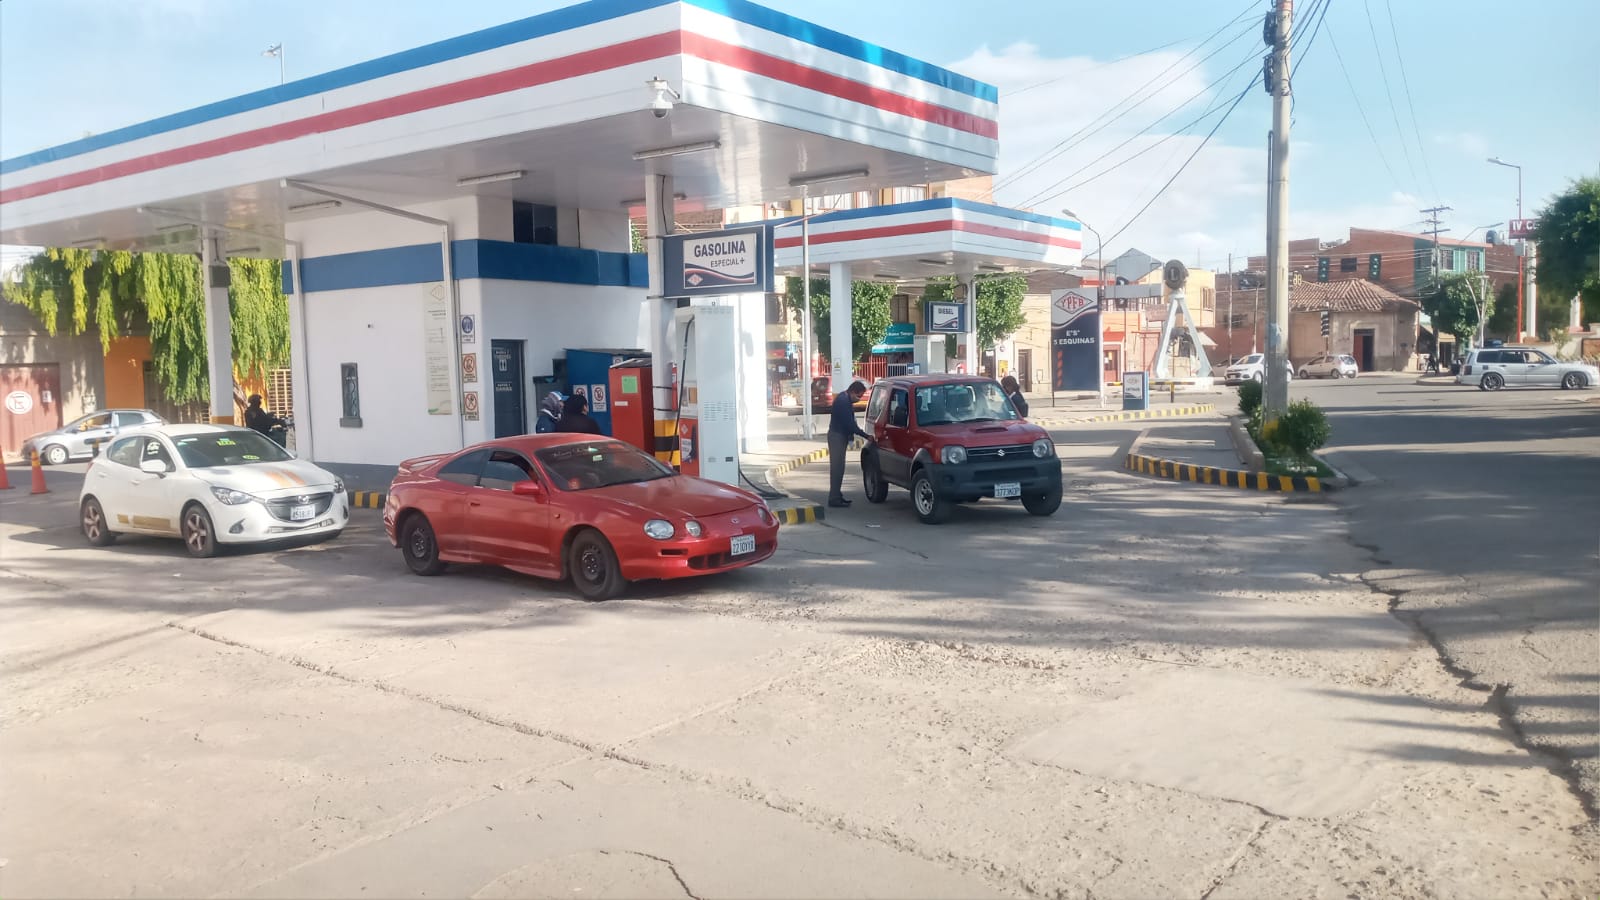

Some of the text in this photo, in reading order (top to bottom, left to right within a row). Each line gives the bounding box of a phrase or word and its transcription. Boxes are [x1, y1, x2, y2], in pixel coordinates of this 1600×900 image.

[694, 240, 746, 258] GASOLINA
[1061, 296, 1084, 310] YPFB
[938, 307, 954, 315] DIESEL
[1059, 337, 1095, 345] ESQUINAS
